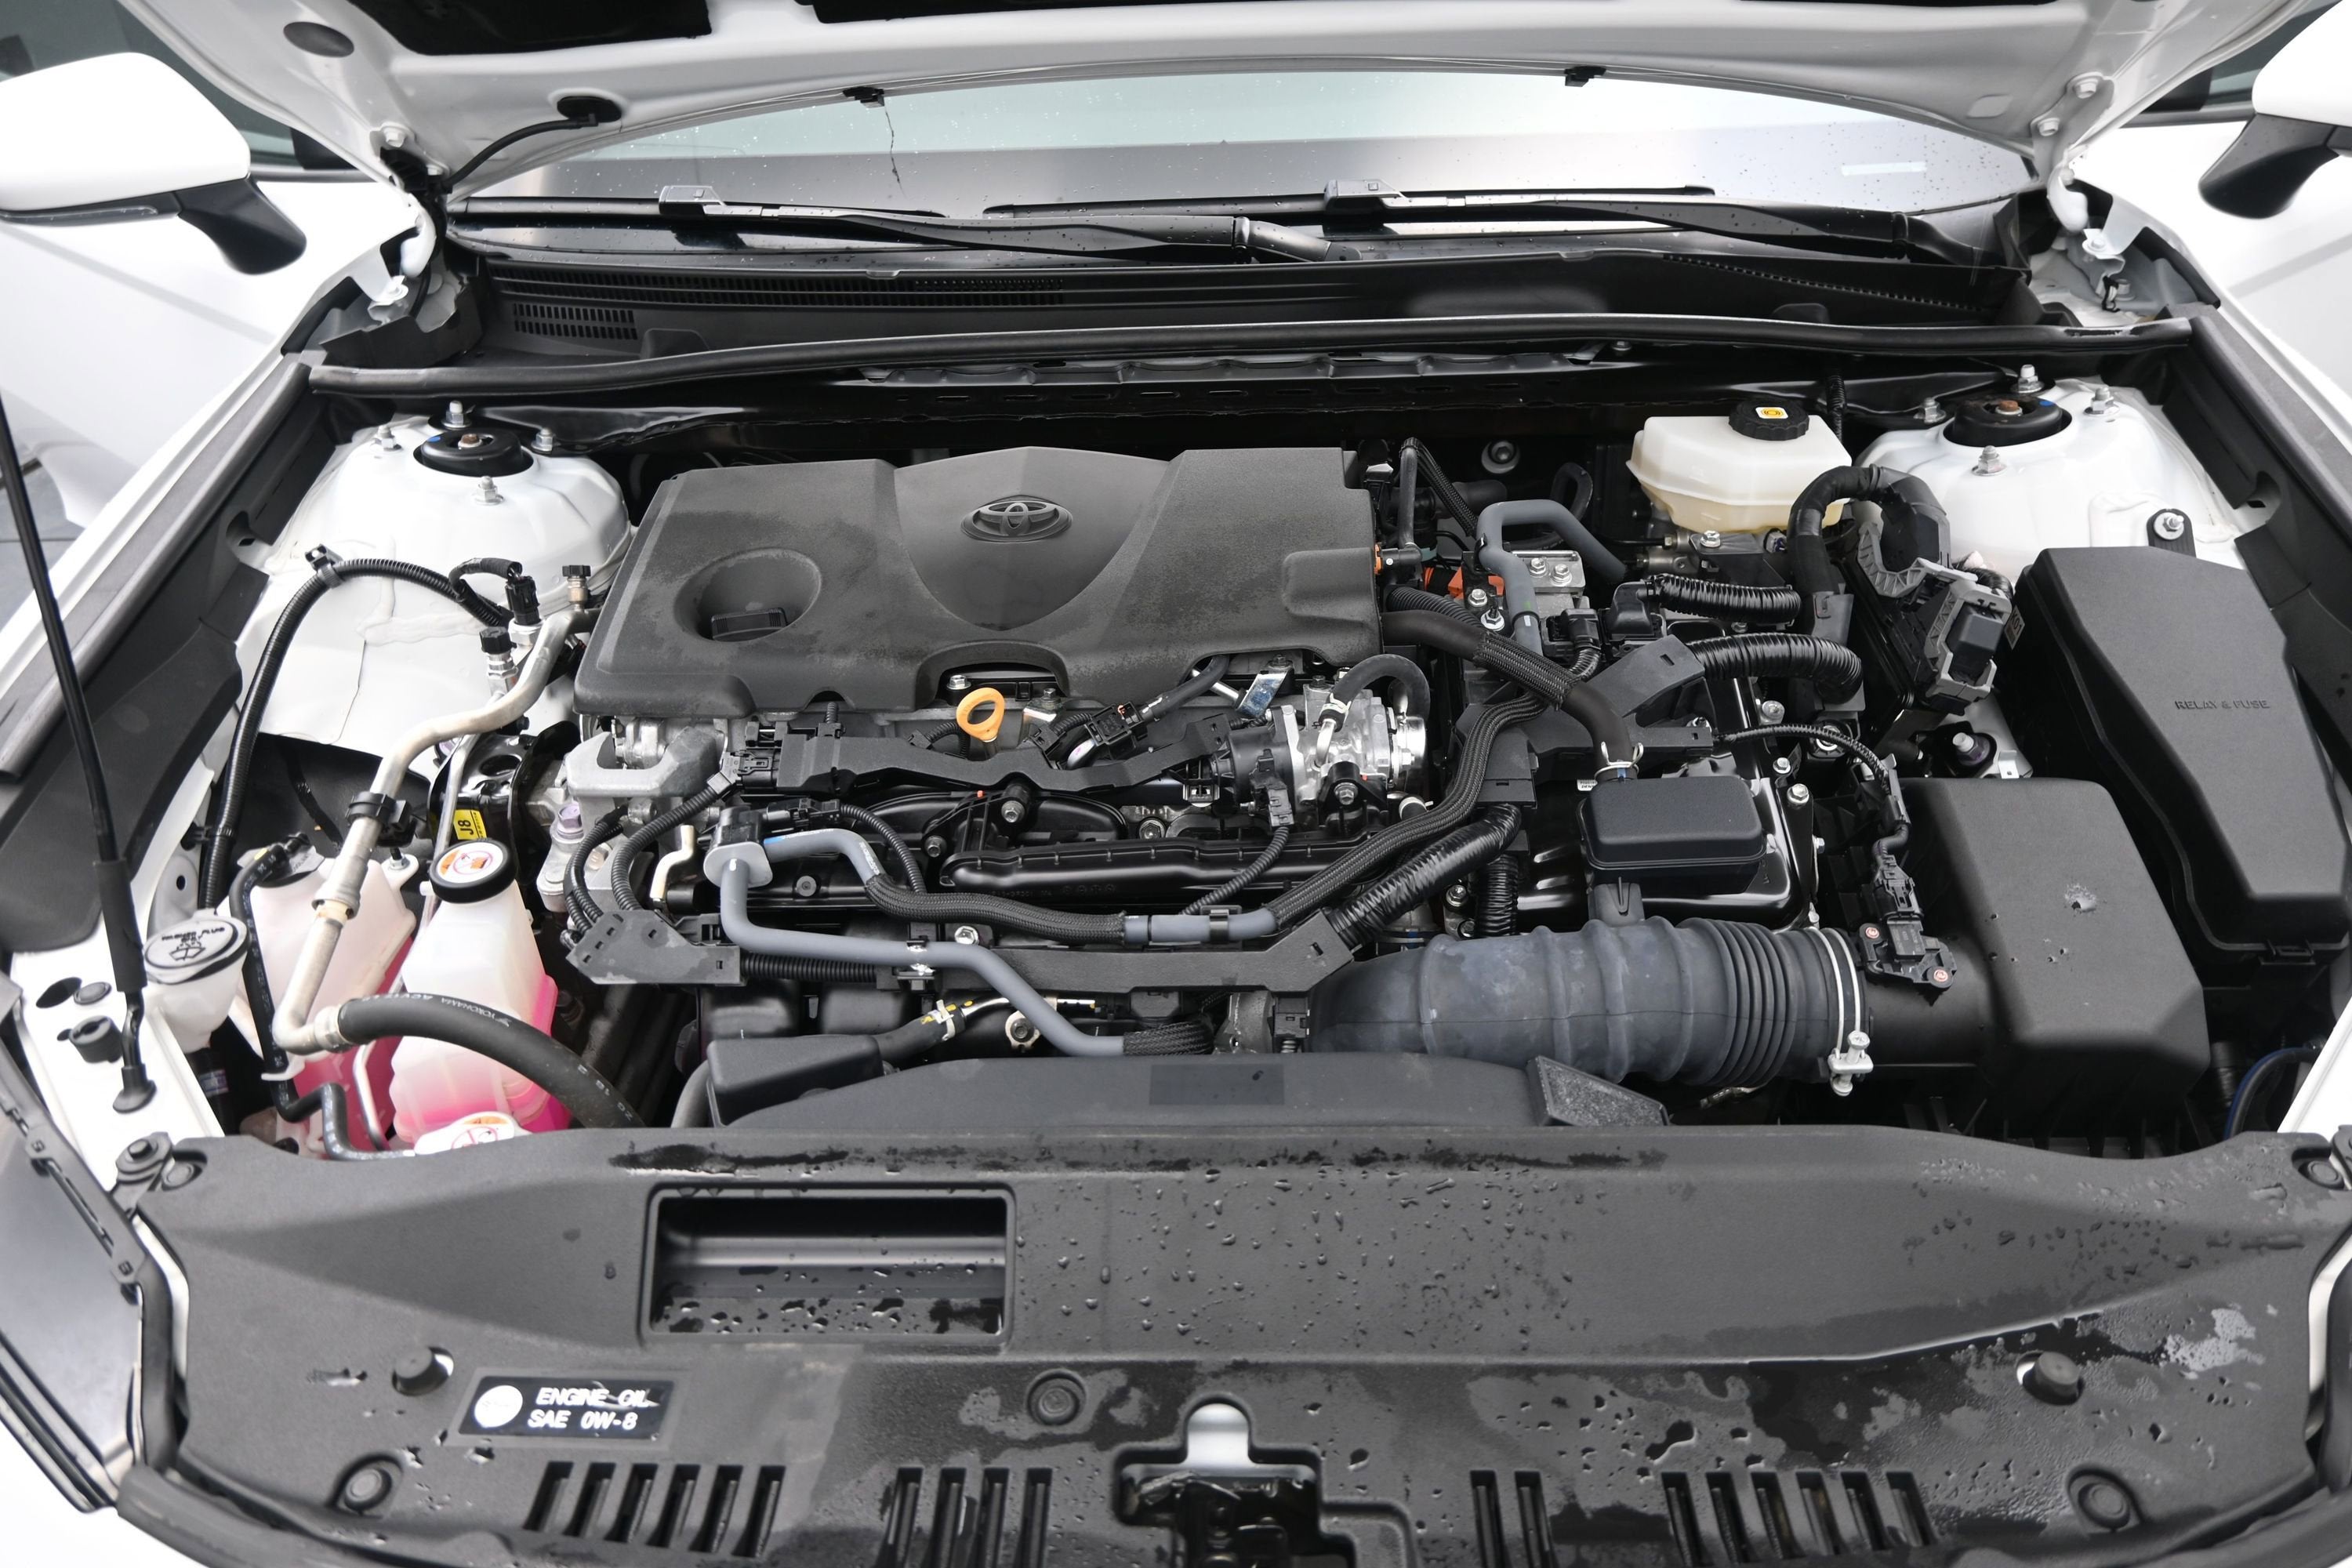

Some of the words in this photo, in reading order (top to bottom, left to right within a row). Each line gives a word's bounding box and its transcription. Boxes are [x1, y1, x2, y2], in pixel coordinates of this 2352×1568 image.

[2175, 700, 2217, 710] RELAY
[2234, 700, 2270, 709] FUSE
[457, 819, 474, 836] J8
[536, 1387, 609, 1406] ENGINE
[618, 1389, 649, 1407] OIL
[528, 1410, 571, 1428] SAE
[581, 1411, 638, 1430] 0W-8
